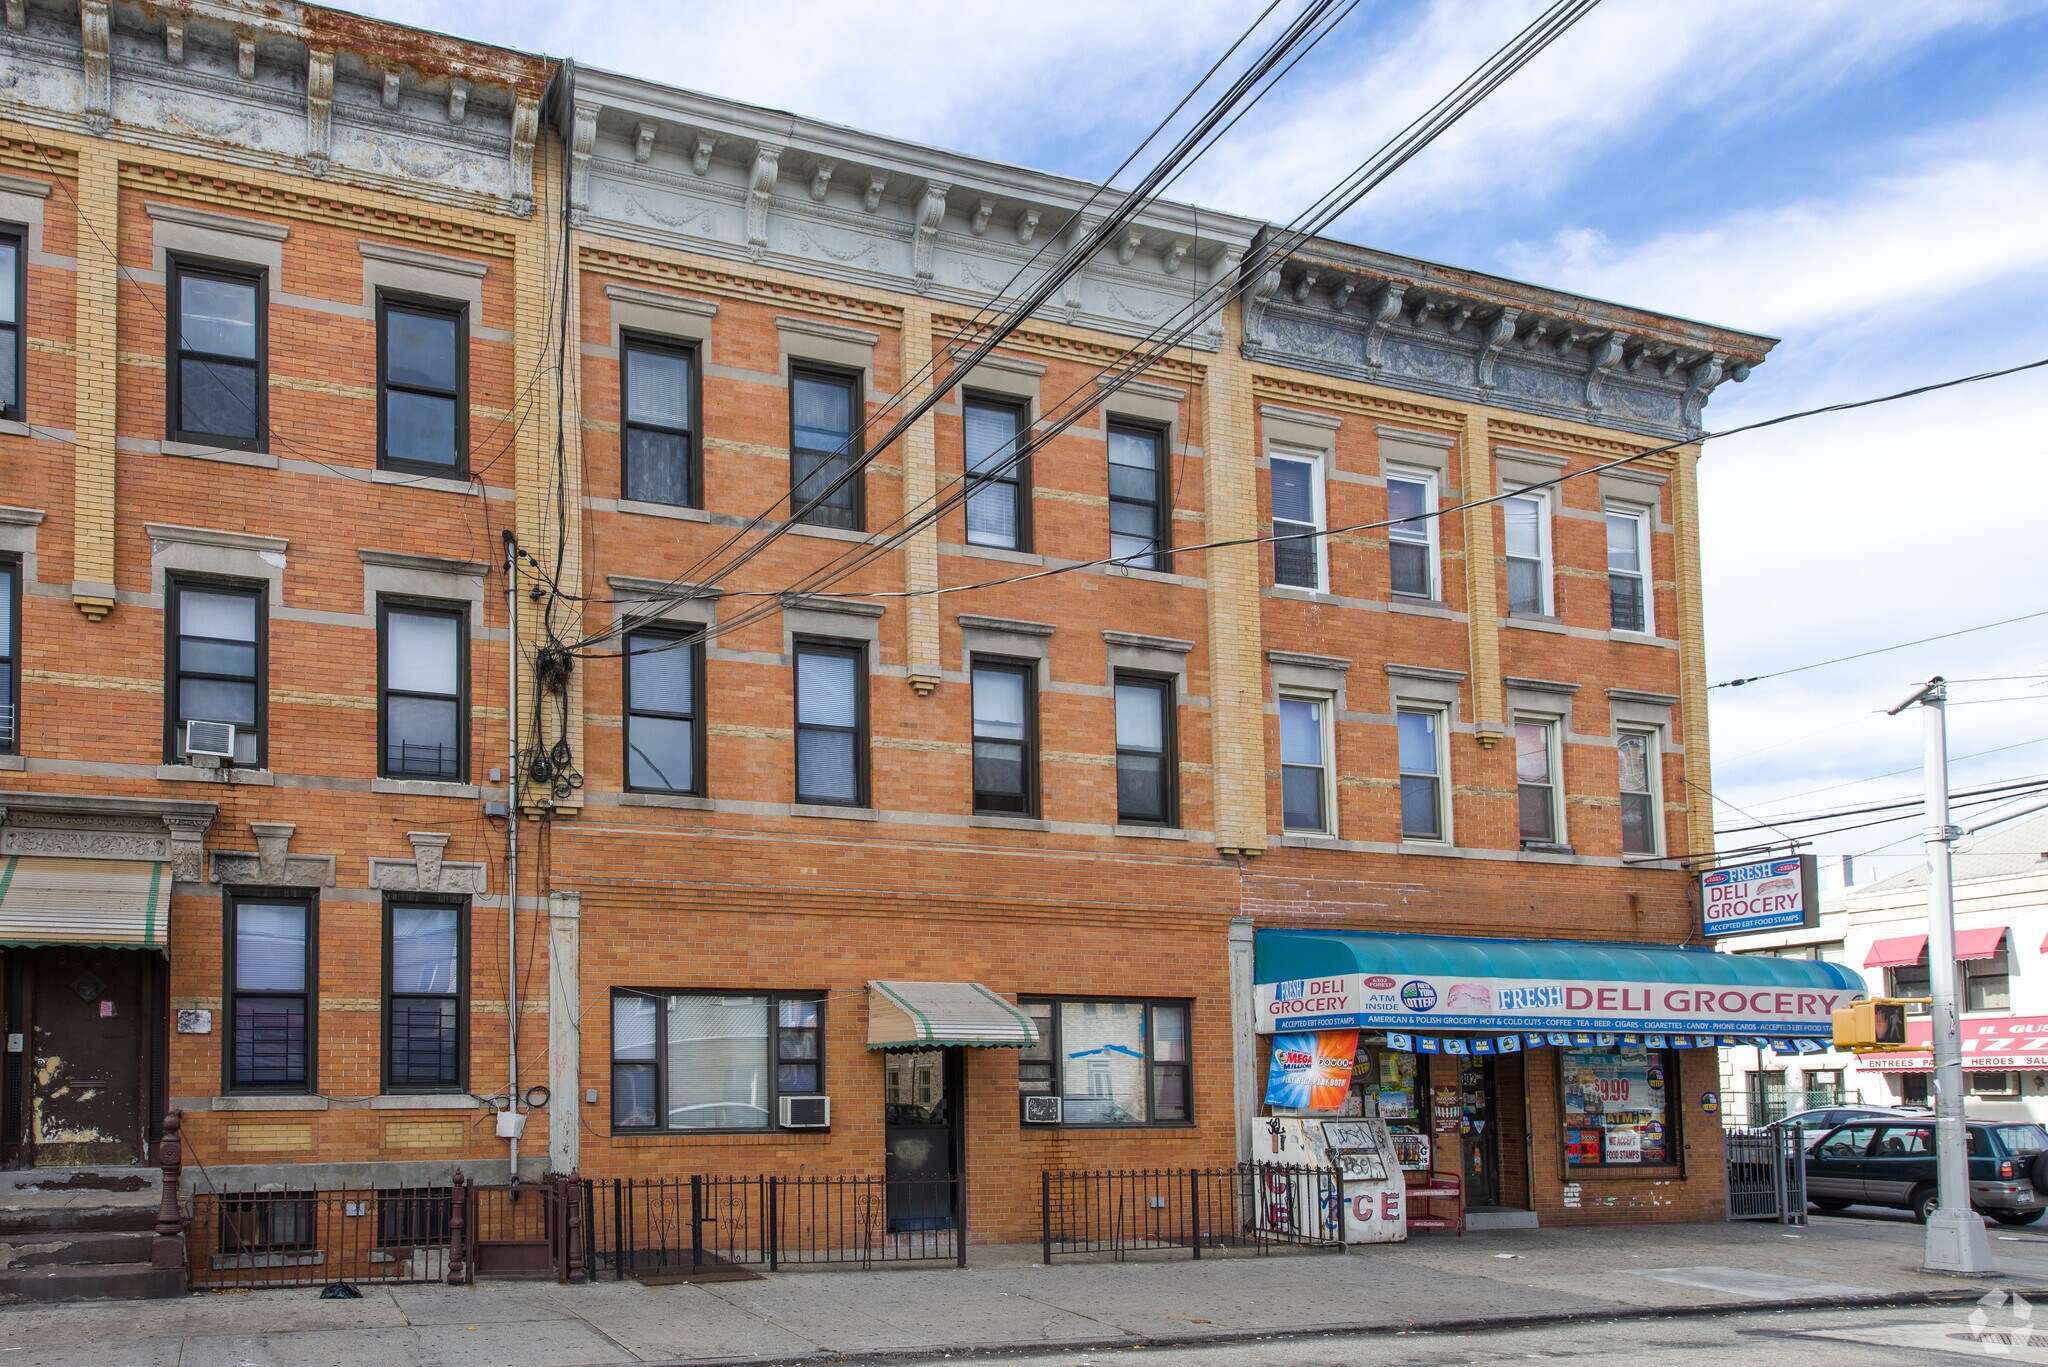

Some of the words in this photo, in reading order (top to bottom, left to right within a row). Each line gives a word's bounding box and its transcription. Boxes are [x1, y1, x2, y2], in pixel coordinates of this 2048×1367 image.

[1729, 864, 1773, 882] FRESH
[1711, 883, 1748, 902] DELI
[1706, 893, 1799, 920] GROCERY
[1710, 921, 1741, 932] ACCEPTED
[1742, 920, 1753, 928] EBT
[1754, 917, 1773, 926] FOOD
[1774, 914, 1799, 924] STAMPS
[1281, 979, 1303, 1001] FRESH
[1310, 980, 1344, 995] DELI
[1269, 996, 1348, 1014] GROCERY
[1369, 994, 1395, 1002] ATM
[1499, 986, 1562, 1010] FRESH
[1566, 987, 1651, 1011] DELI
[1663, 990, 1839, 1015] GROCERY
[1365, 1002, 1398, 1010] INSIDE
[1282, 1019, 1307, 1028] ACCEPTED
[1317, 1018, 1333, 1026] FOOD
[1333, 1017, 1355, 1025] STAMPS
[1368, 1015, 1408, 1023] AMERICAN
[1409, 1016, 1415, 1024] &
[1416, 1016, 1442, 1024] POLISH
[1524, 1018, 1542, 1026] CUTS
[1545, 1019, 1572, 1027] COFFEE
[1644, 1021, 1682, 1029] CIGARETTES
[1804, 1024, 1822, 1032] FOOD
[1978, 1026, 1999, 1035] IL
[1286, 1051, 1313, 1064] MEGA
[1869, 1060, 1914, 1068] ENTREES
[1971, 1057, 2015, 1066] HEROES
[1594, 1078, 1630, 1102] $9.99
[1606, 1112, 1633, 1123] ATM
[1608, 1136, 1617, 1146] WE
[1617, 1136, 1636, 1146] ACCEPT
[1606, 1150, 1619, 1160] FOOD
[1619, 1150, 1640, 1160] STAMPS
